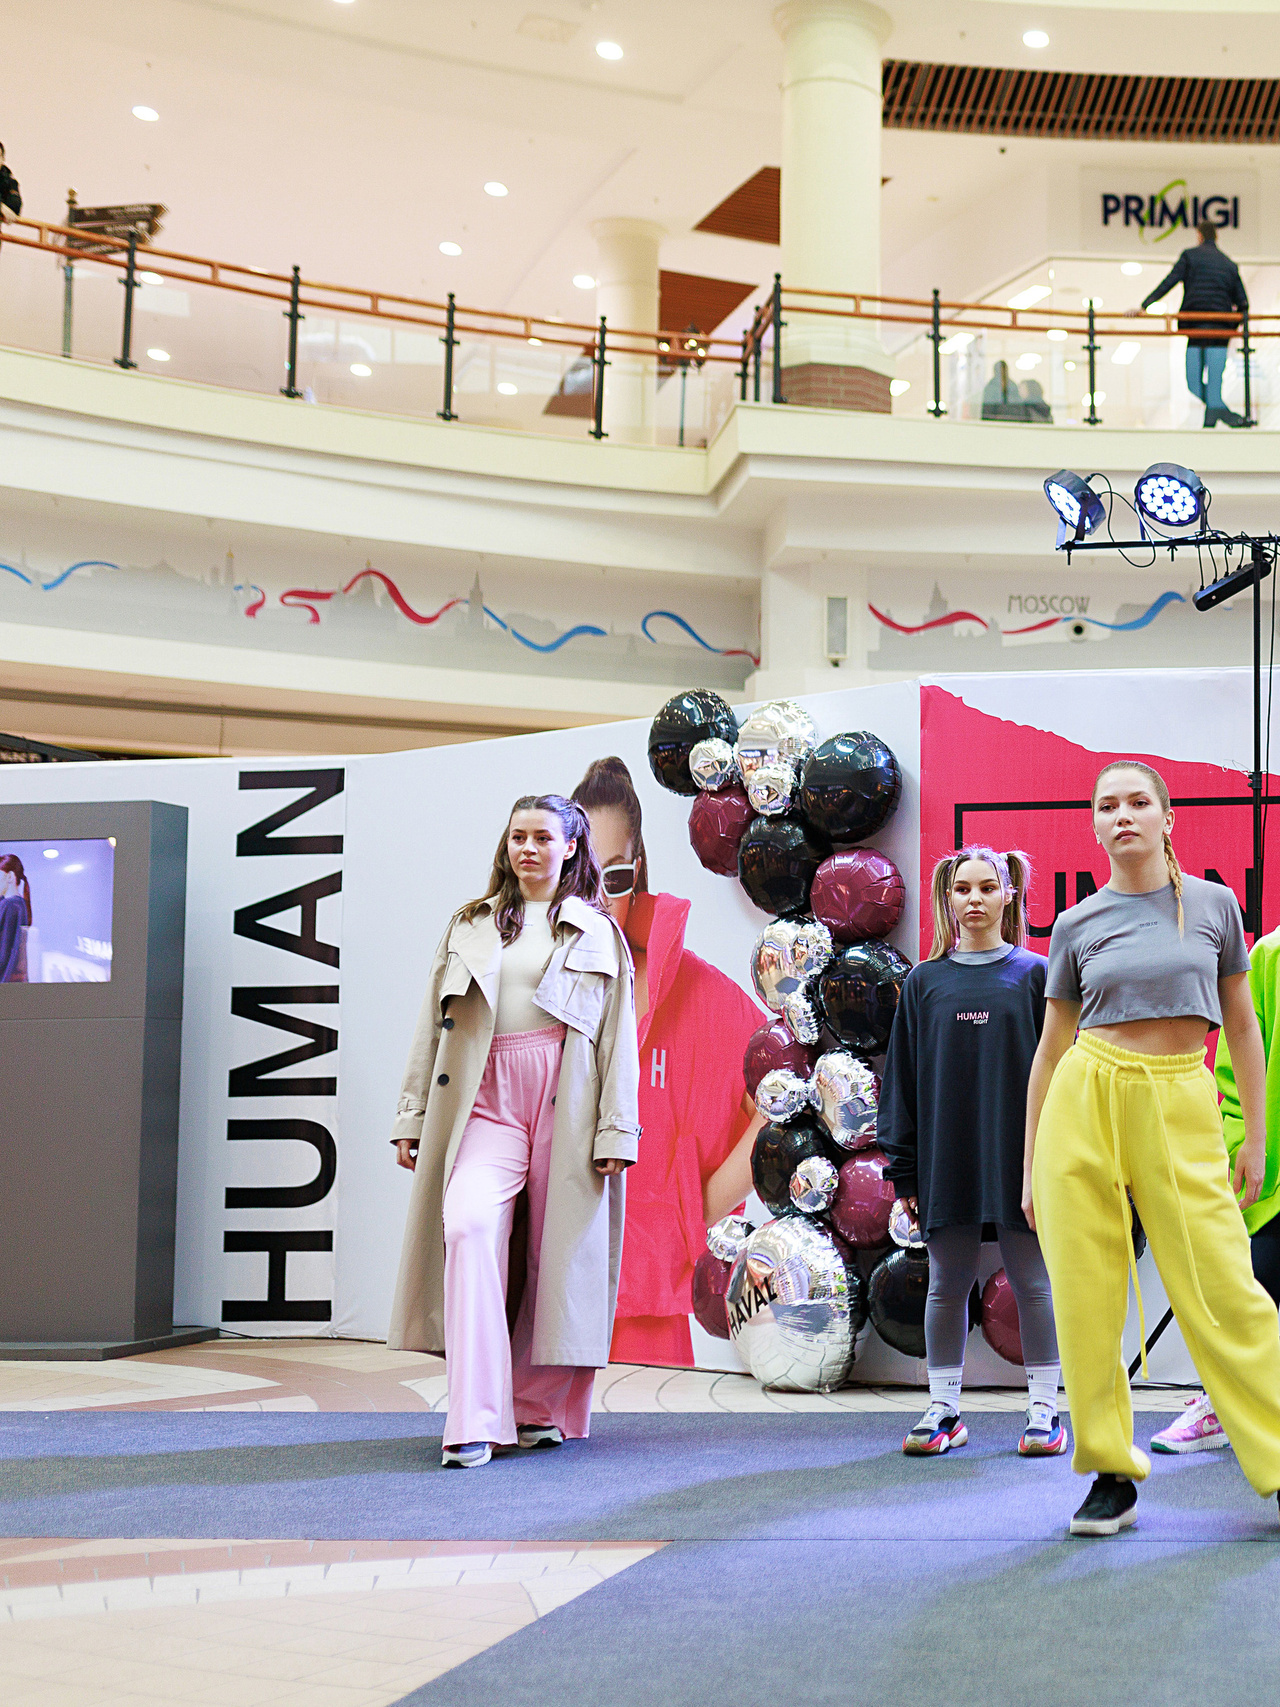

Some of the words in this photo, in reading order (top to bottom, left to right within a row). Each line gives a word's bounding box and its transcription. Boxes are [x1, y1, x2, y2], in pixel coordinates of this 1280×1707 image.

[1102, 194, 1239, 230] PRIMIGI
[1008, 594, 1090, 614] MOSCOW
[956, 1011, 989, 1021] HUMAN
[221, 767, 346, 1322] HUMAN
[728, 1276, 778, 1341] HAVAL
